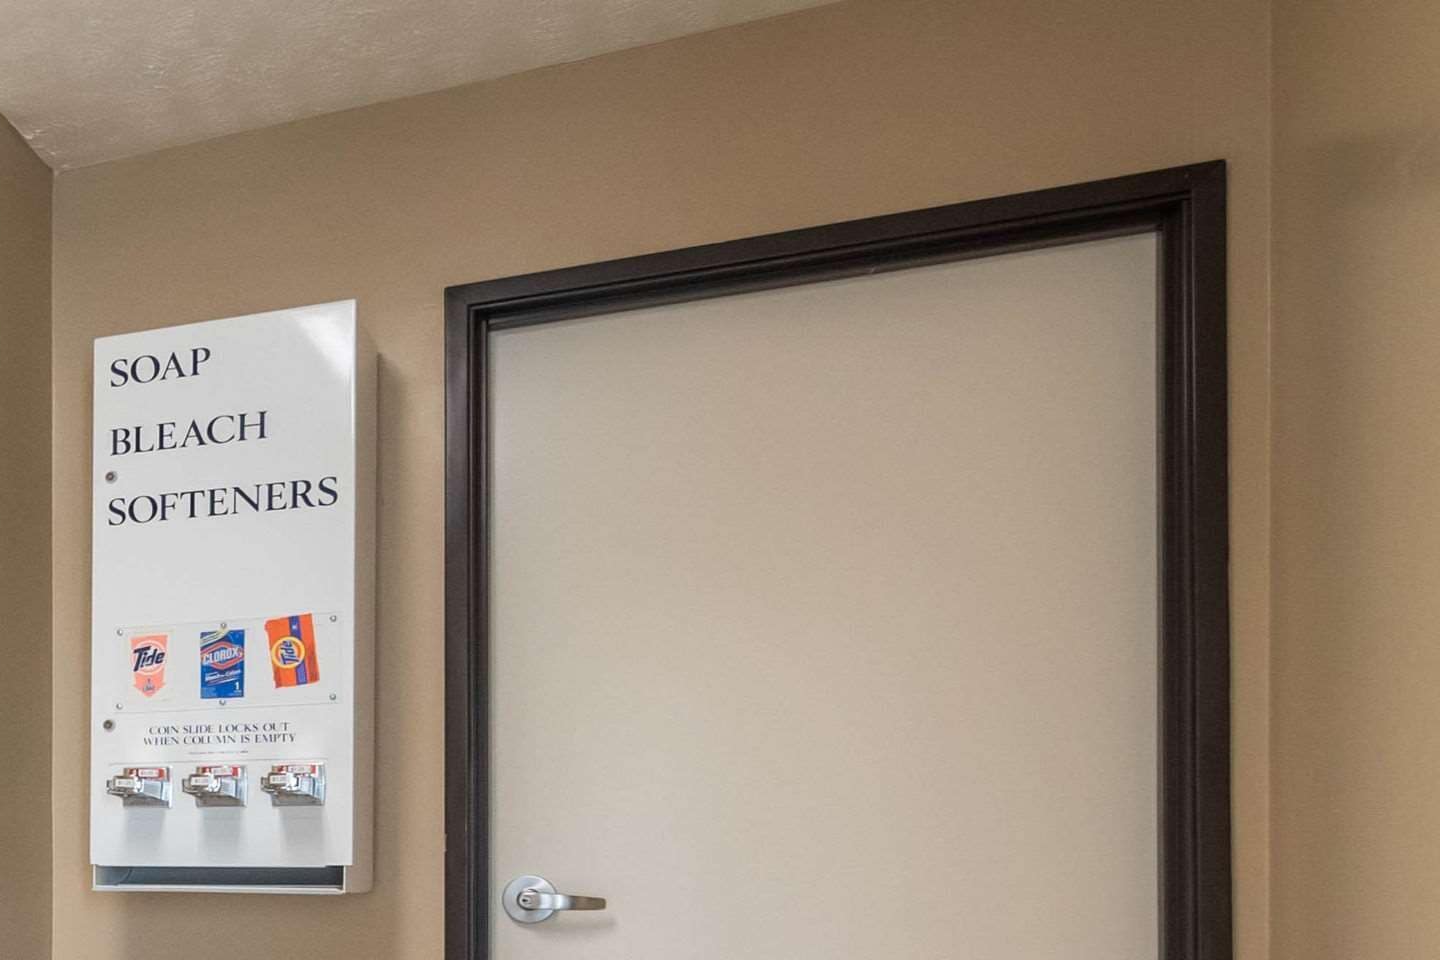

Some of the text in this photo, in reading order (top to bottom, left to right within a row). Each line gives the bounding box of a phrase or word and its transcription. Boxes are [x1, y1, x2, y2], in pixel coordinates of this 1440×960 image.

[110, 347, 211, 387] SOAP
[110, 411, 268, 456] BLEACH
[108, 476, 339, 526] SOFTENERS
[133, 646, 165, 672] Tide
[202, 647, 240, 666] CLOROX
[279, 639, 300, 665] Tide
[143, 732, 296, 746] WHEN COLUMN IS EMPTY
[148, 721, 291, 735] COIN SLIDE LOCKS OUT
